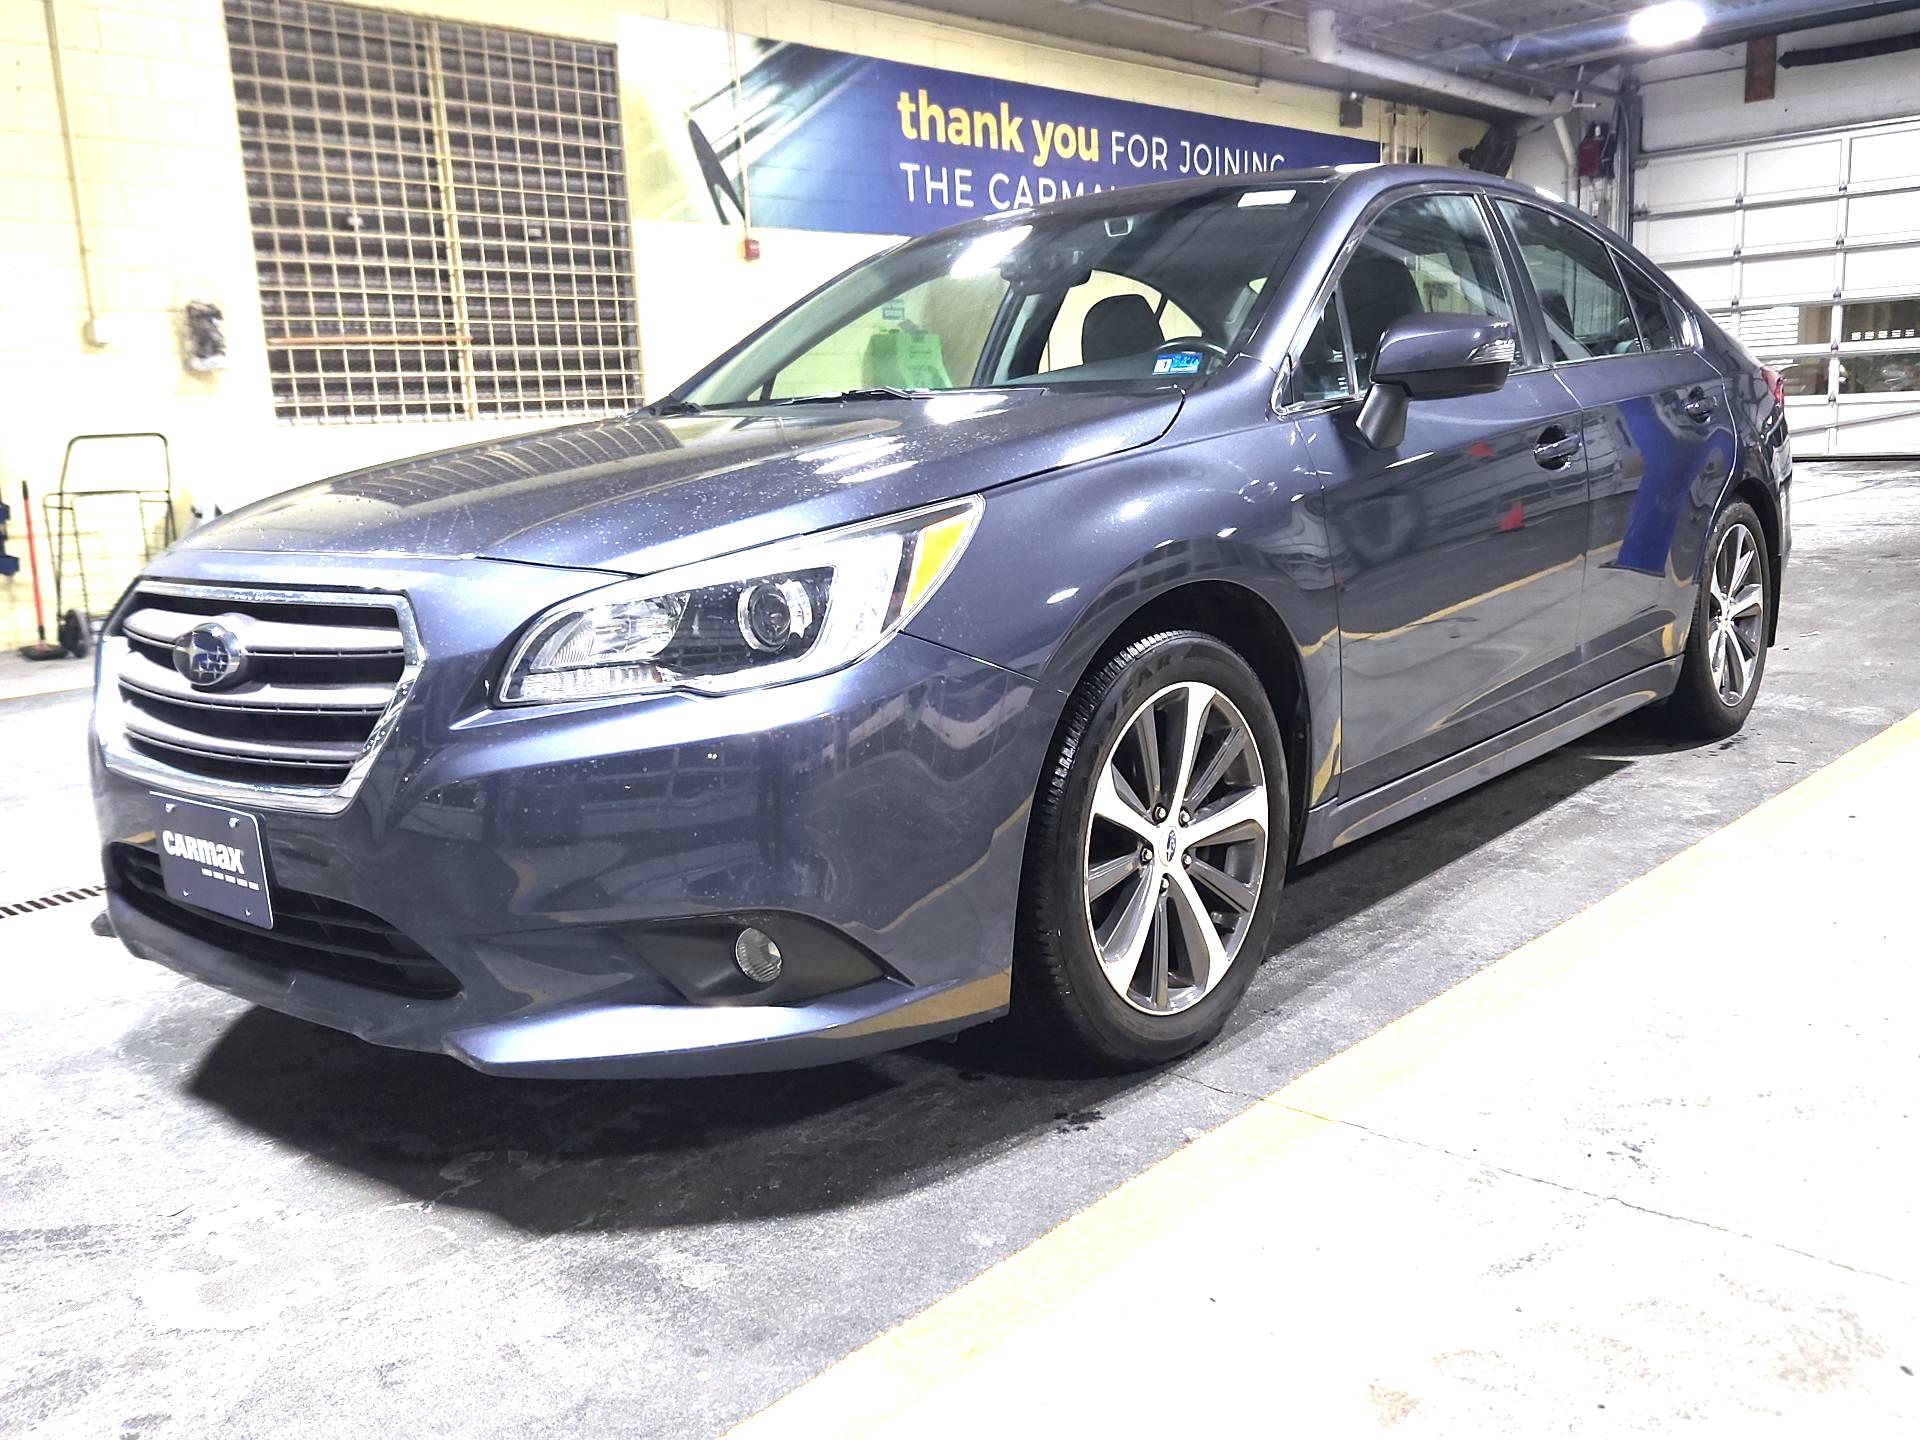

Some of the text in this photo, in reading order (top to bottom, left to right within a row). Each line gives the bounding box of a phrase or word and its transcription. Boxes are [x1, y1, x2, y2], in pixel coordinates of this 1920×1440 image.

[897, 89, 1024, 152] thank
[1031, 119, 1099, 167] you
[1112, 131, 1168, 171] FOR
[900, 162, 1115, 210] THE CARM
